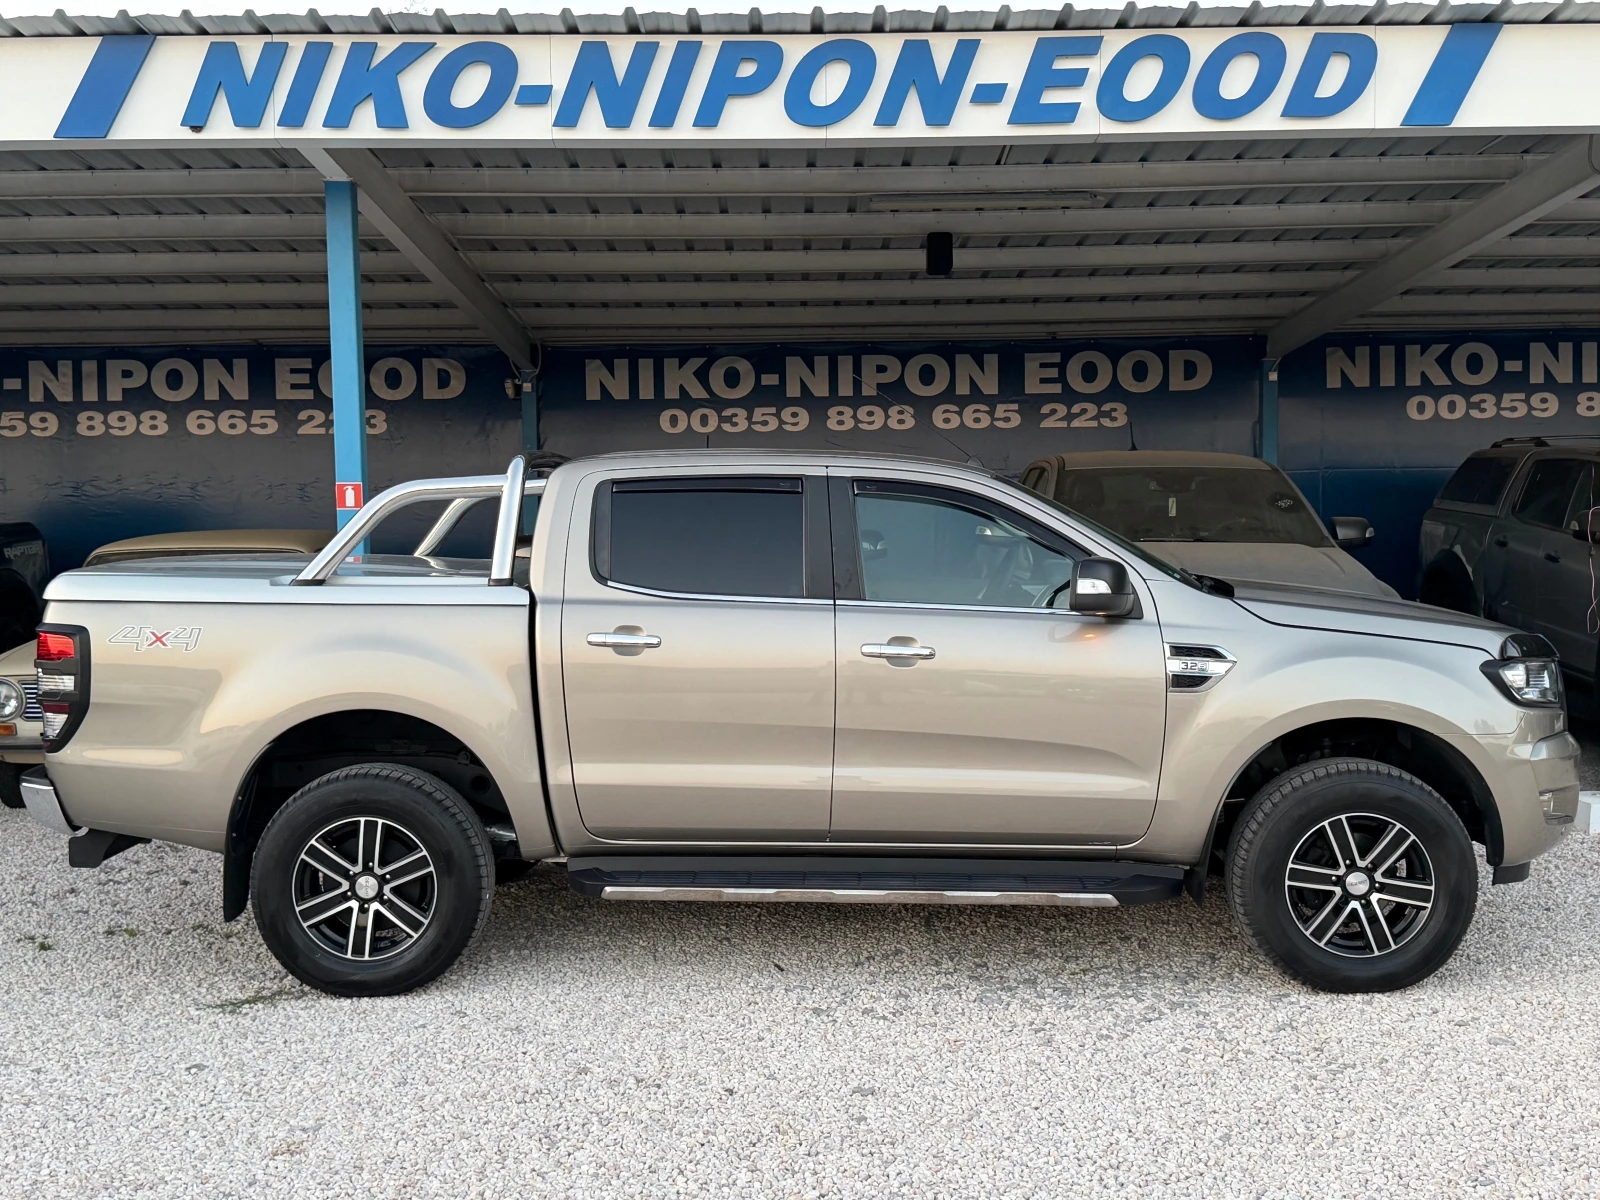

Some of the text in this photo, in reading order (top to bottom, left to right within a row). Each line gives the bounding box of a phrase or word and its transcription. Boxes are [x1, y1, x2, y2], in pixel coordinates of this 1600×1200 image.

[181, 32, 1378, 129] NIKO-NIPON-EOOD
[585, 349, 1213, 401] NIKO-NIPON EOOD
[1326, 341, 1598, 389] NIKO-NI
[0, 408, 388, 437] 59 898 665 23
[659, 401, 1129, 434] 00359 898 665 223
[1405, 391, 1560, 421] 00359
